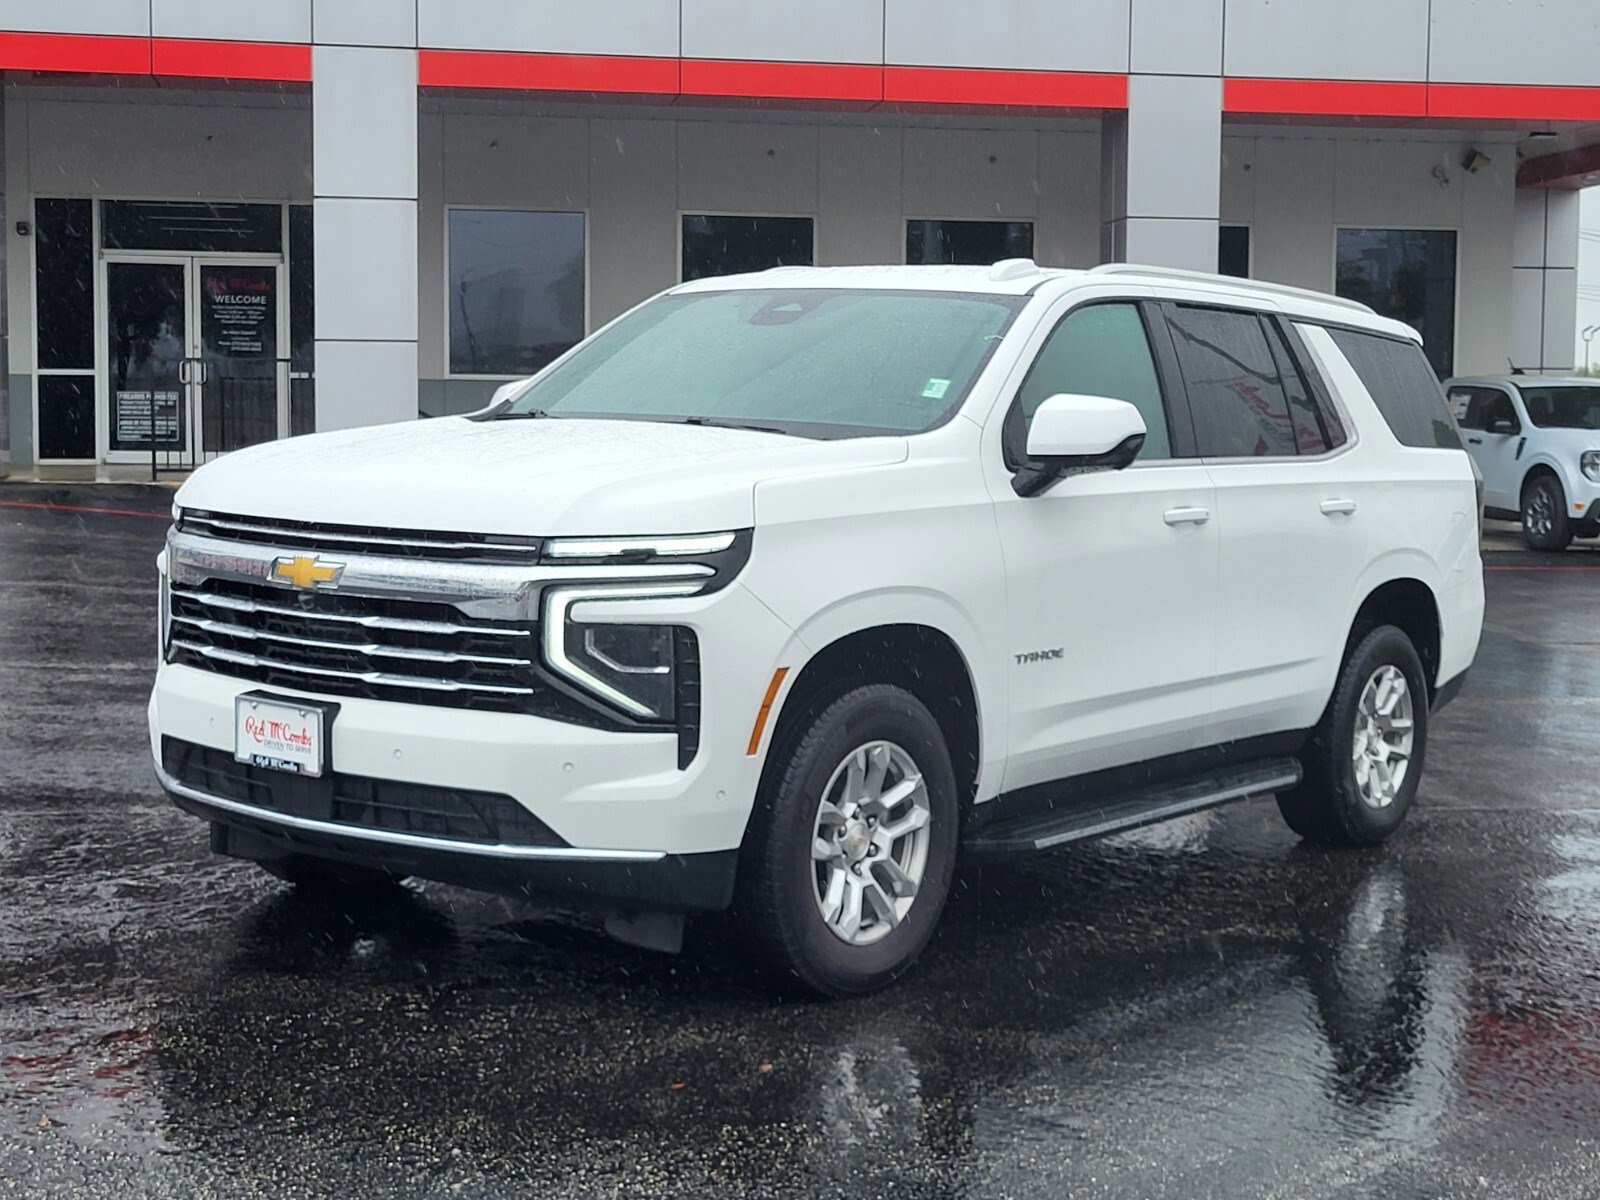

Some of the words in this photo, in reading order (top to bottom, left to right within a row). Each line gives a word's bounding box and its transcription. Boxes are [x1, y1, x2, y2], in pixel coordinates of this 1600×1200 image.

[214, 295, 267, 305] WELCOME
[1014, 647, 1064, 665] TAHOE
[245, 715, 265, 743] Red
[268, 720, 312, 746] McCombs
[286, 743, 294, 751] TO
